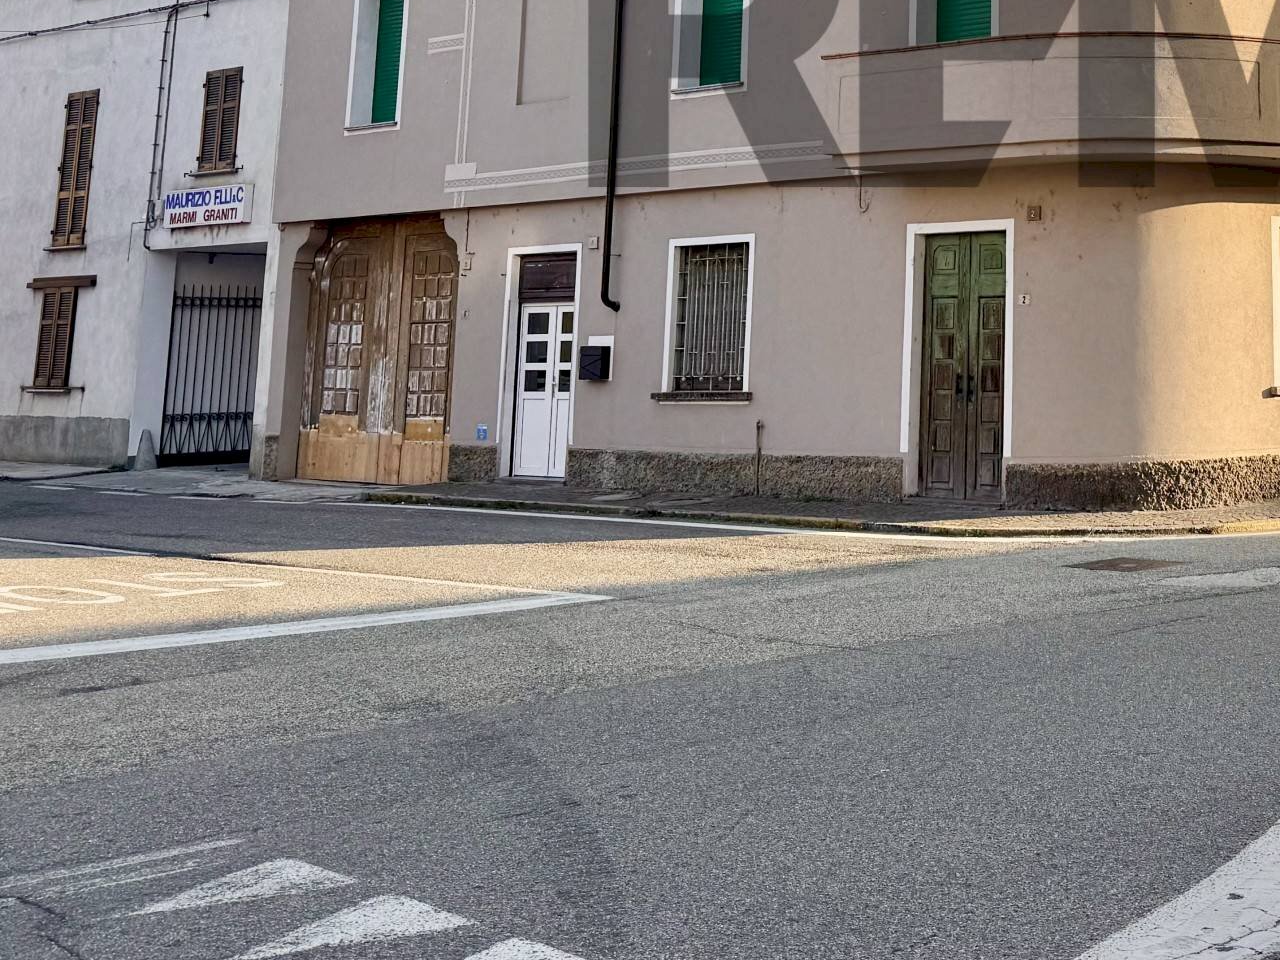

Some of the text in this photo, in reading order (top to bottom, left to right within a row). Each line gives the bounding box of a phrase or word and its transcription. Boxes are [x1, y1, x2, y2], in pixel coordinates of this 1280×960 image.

[166, 191, 211, 208] MAURIZIO
[169, 207, 238, 225] MARMI GRANITI
